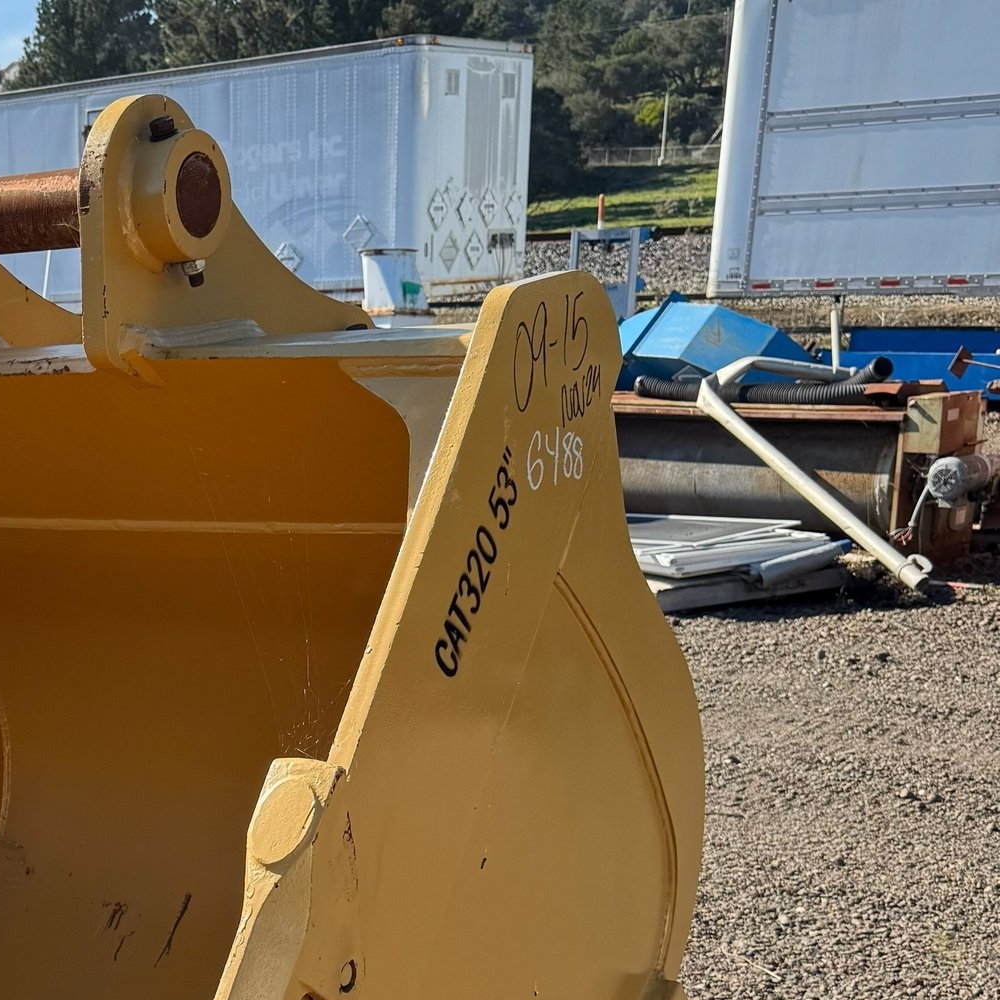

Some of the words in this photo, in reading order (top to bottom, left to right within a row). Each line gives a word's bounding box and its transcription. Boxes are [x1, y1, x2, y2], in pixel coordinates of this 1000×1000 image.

[513, 291, 589, 412] 09-15
[526, 426, 583, 491] 6488
[434, 525, 498, 678] CAT320
[488, 445, 518, 530] 53"
